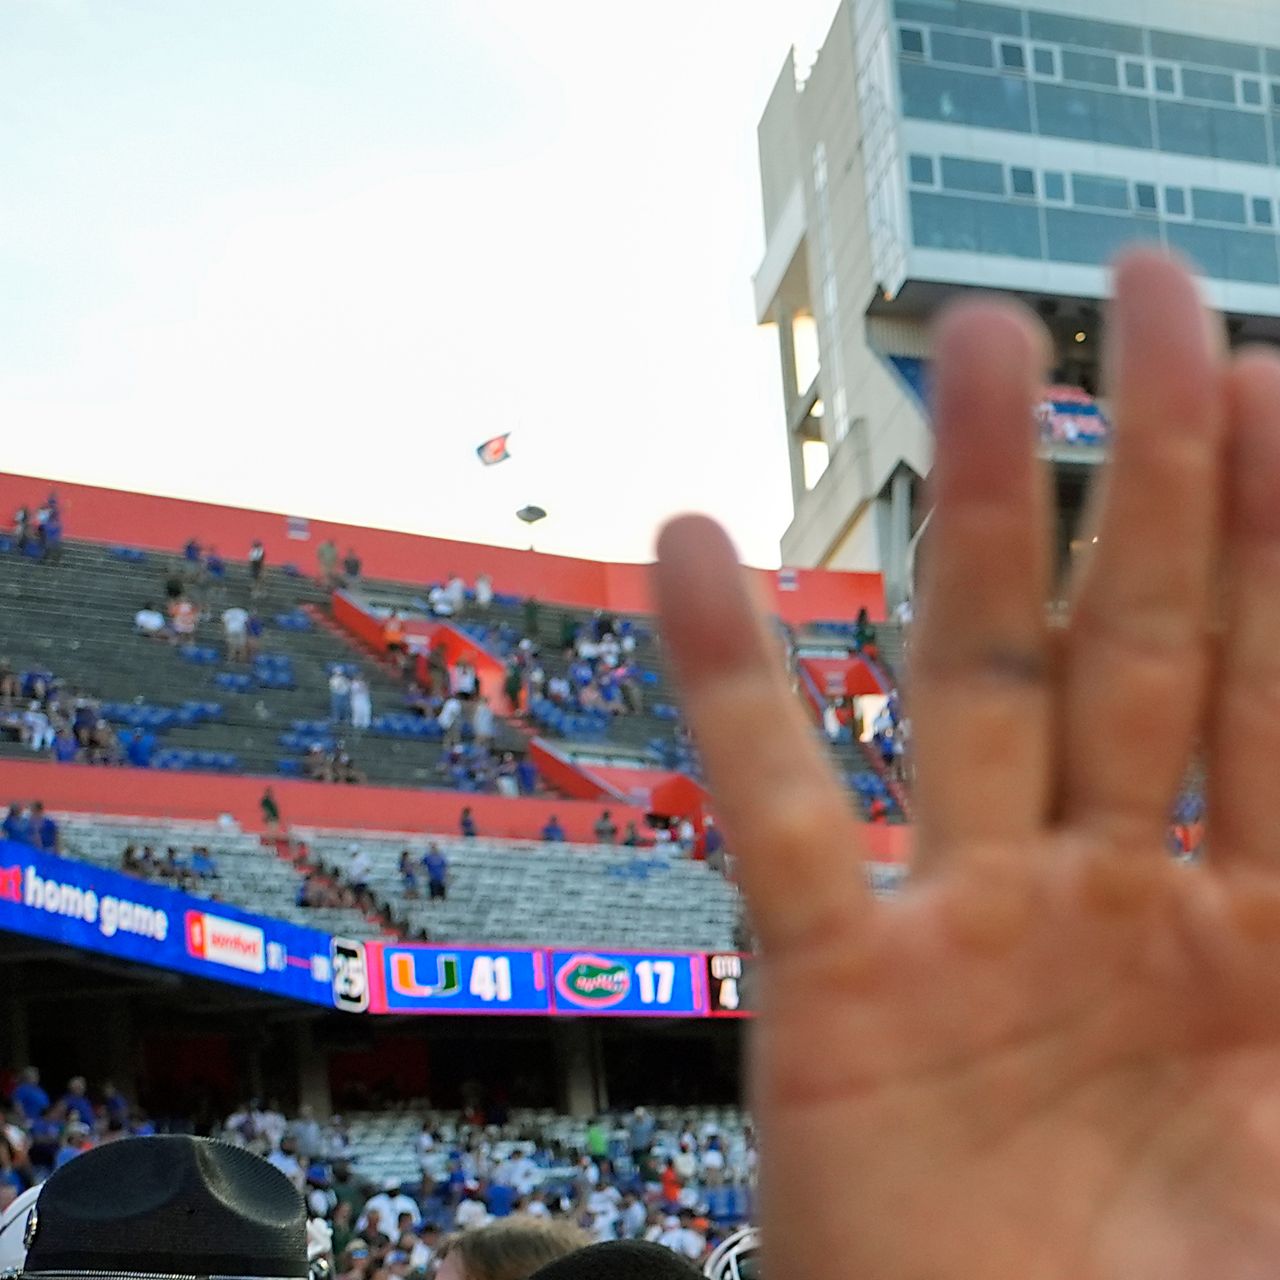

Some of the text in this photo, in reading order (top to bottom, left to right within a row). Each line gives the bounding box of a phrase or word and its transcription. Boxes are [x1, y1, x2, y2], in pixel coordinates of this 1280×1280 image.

[24, 865, 98, 923] home
[100, 895, 168, 941] game
[390, 952, 675, 1004] U 41 17
